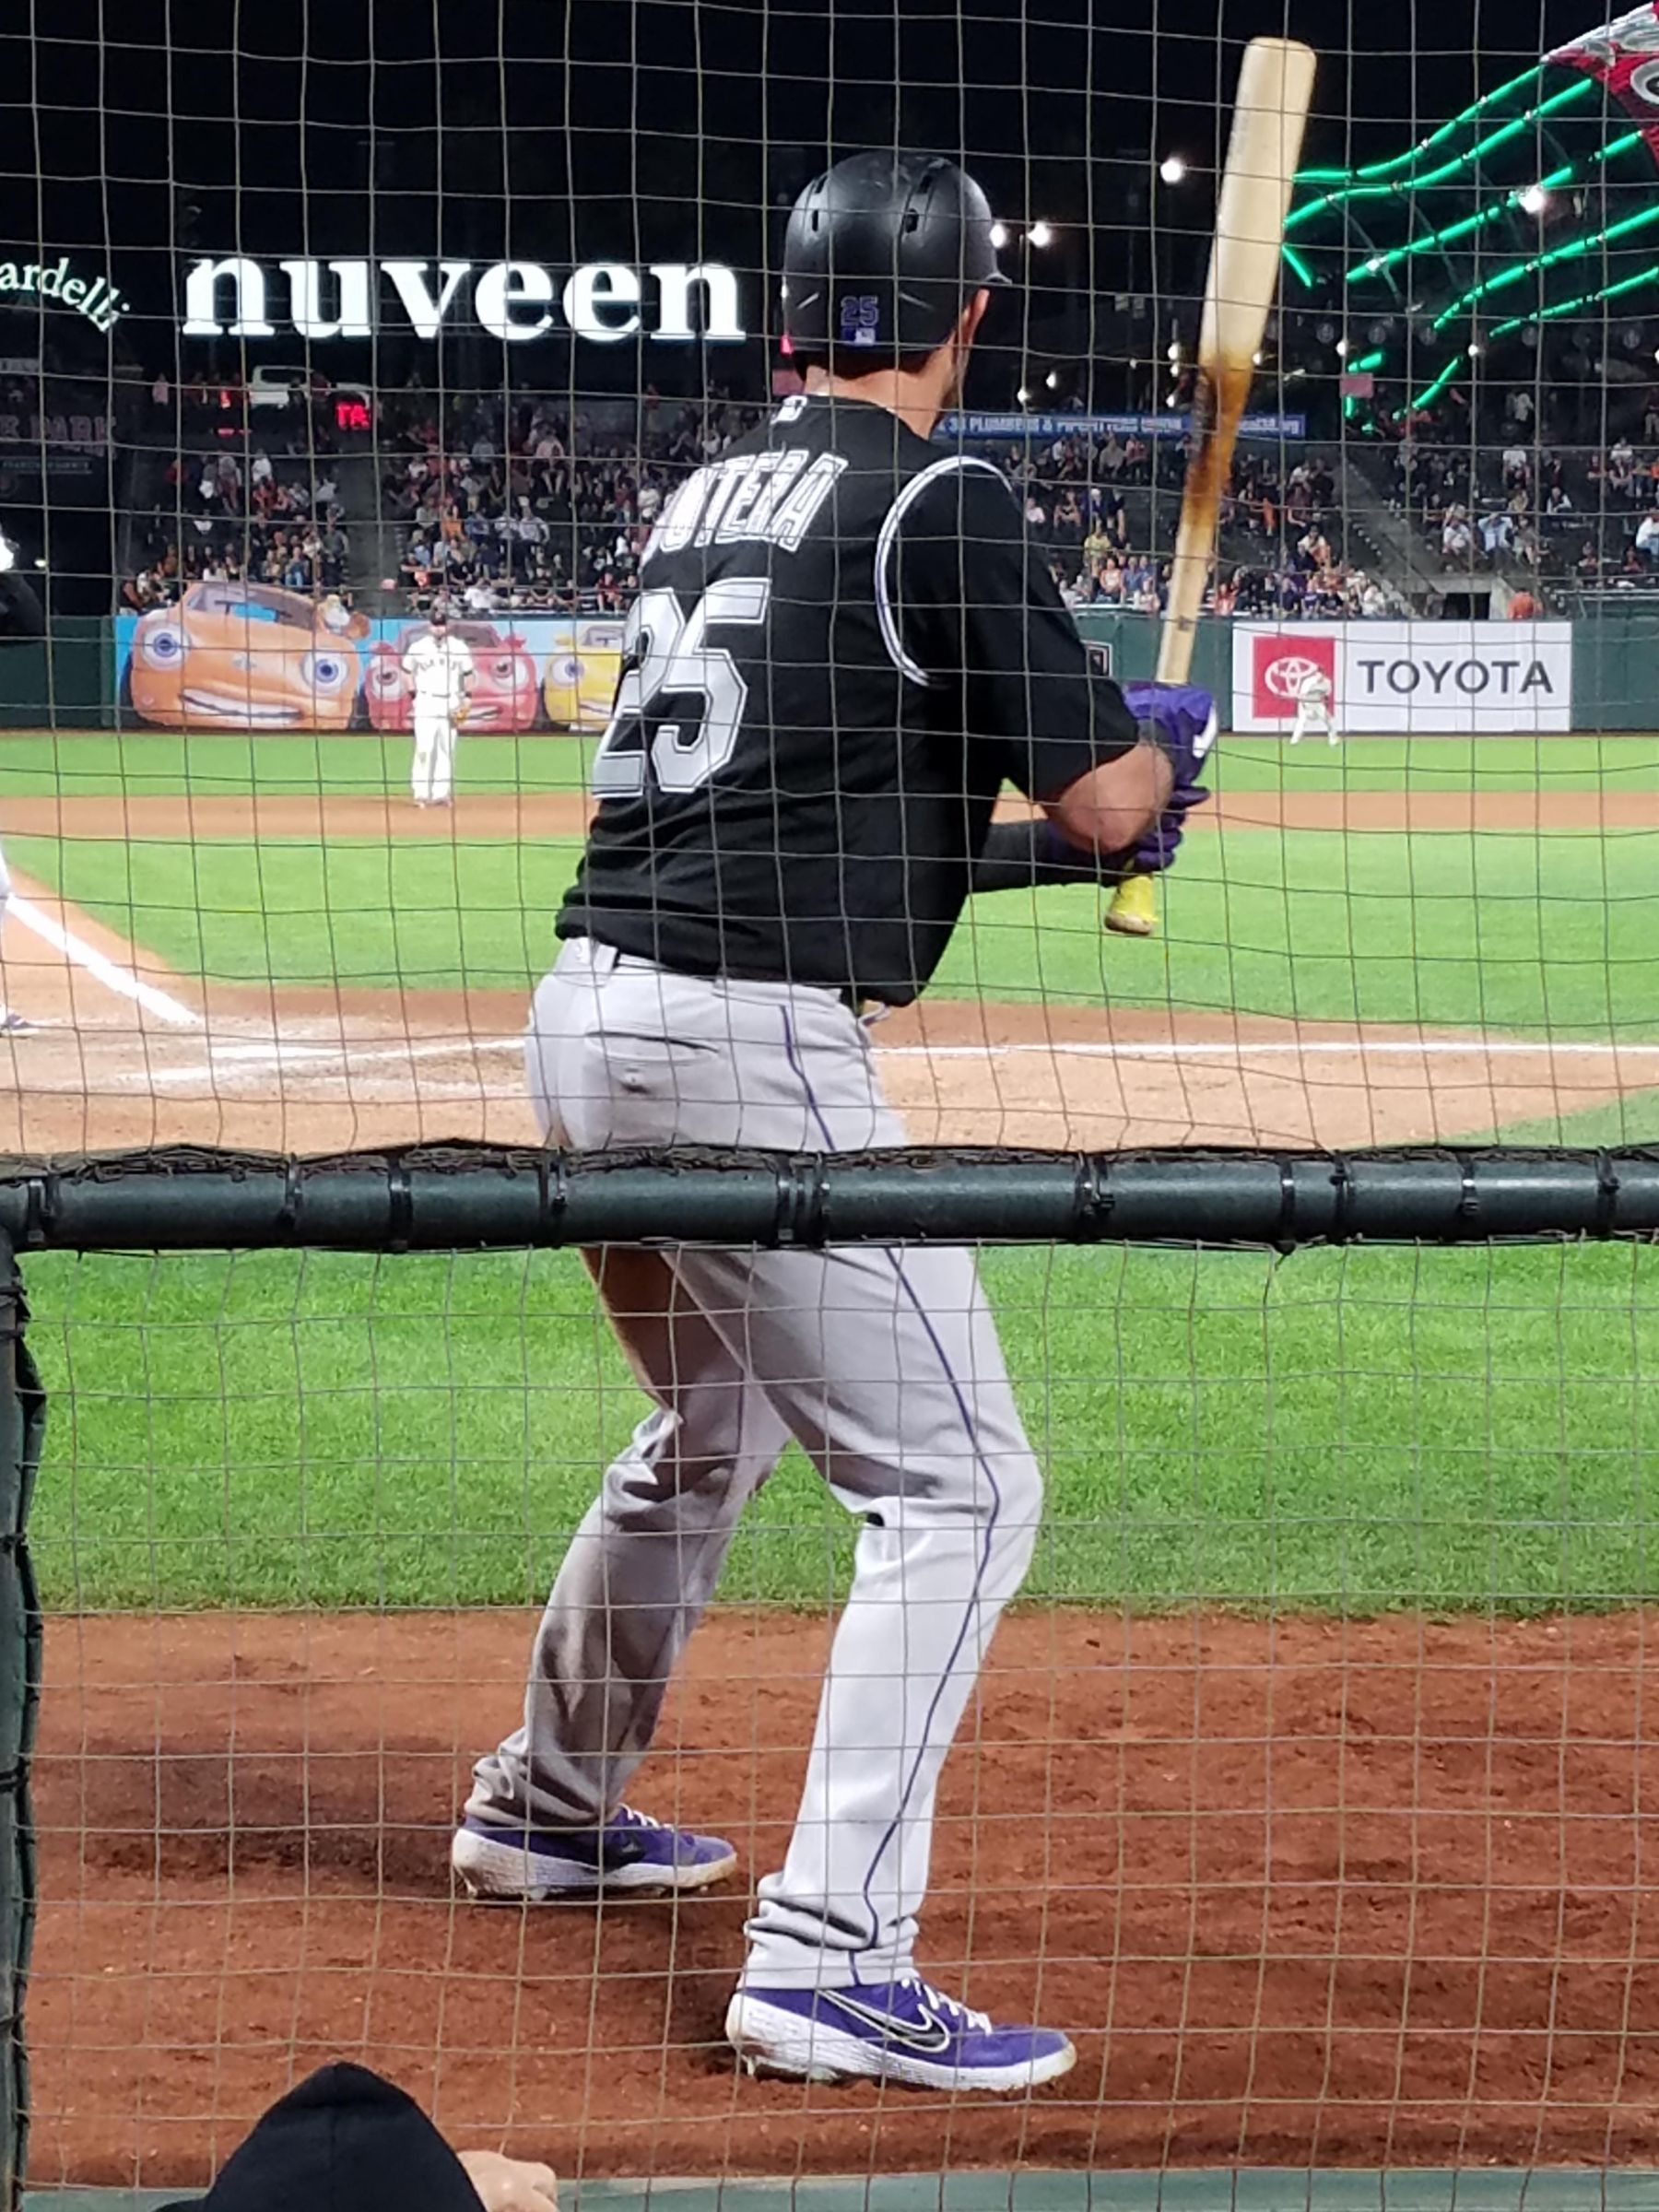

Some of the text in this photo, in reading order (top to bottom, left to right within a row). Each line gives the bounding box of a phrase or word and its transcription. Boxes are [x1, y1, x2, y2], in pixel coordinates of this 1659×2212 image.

[182, 257, 747, 341] nuveen
[840, 295, 879, 327] 25
[640, 449, 849, 571] UTERA
[591, 577, 771, 800] 25
[1357, 659, 1554, 694] TOYOTA
